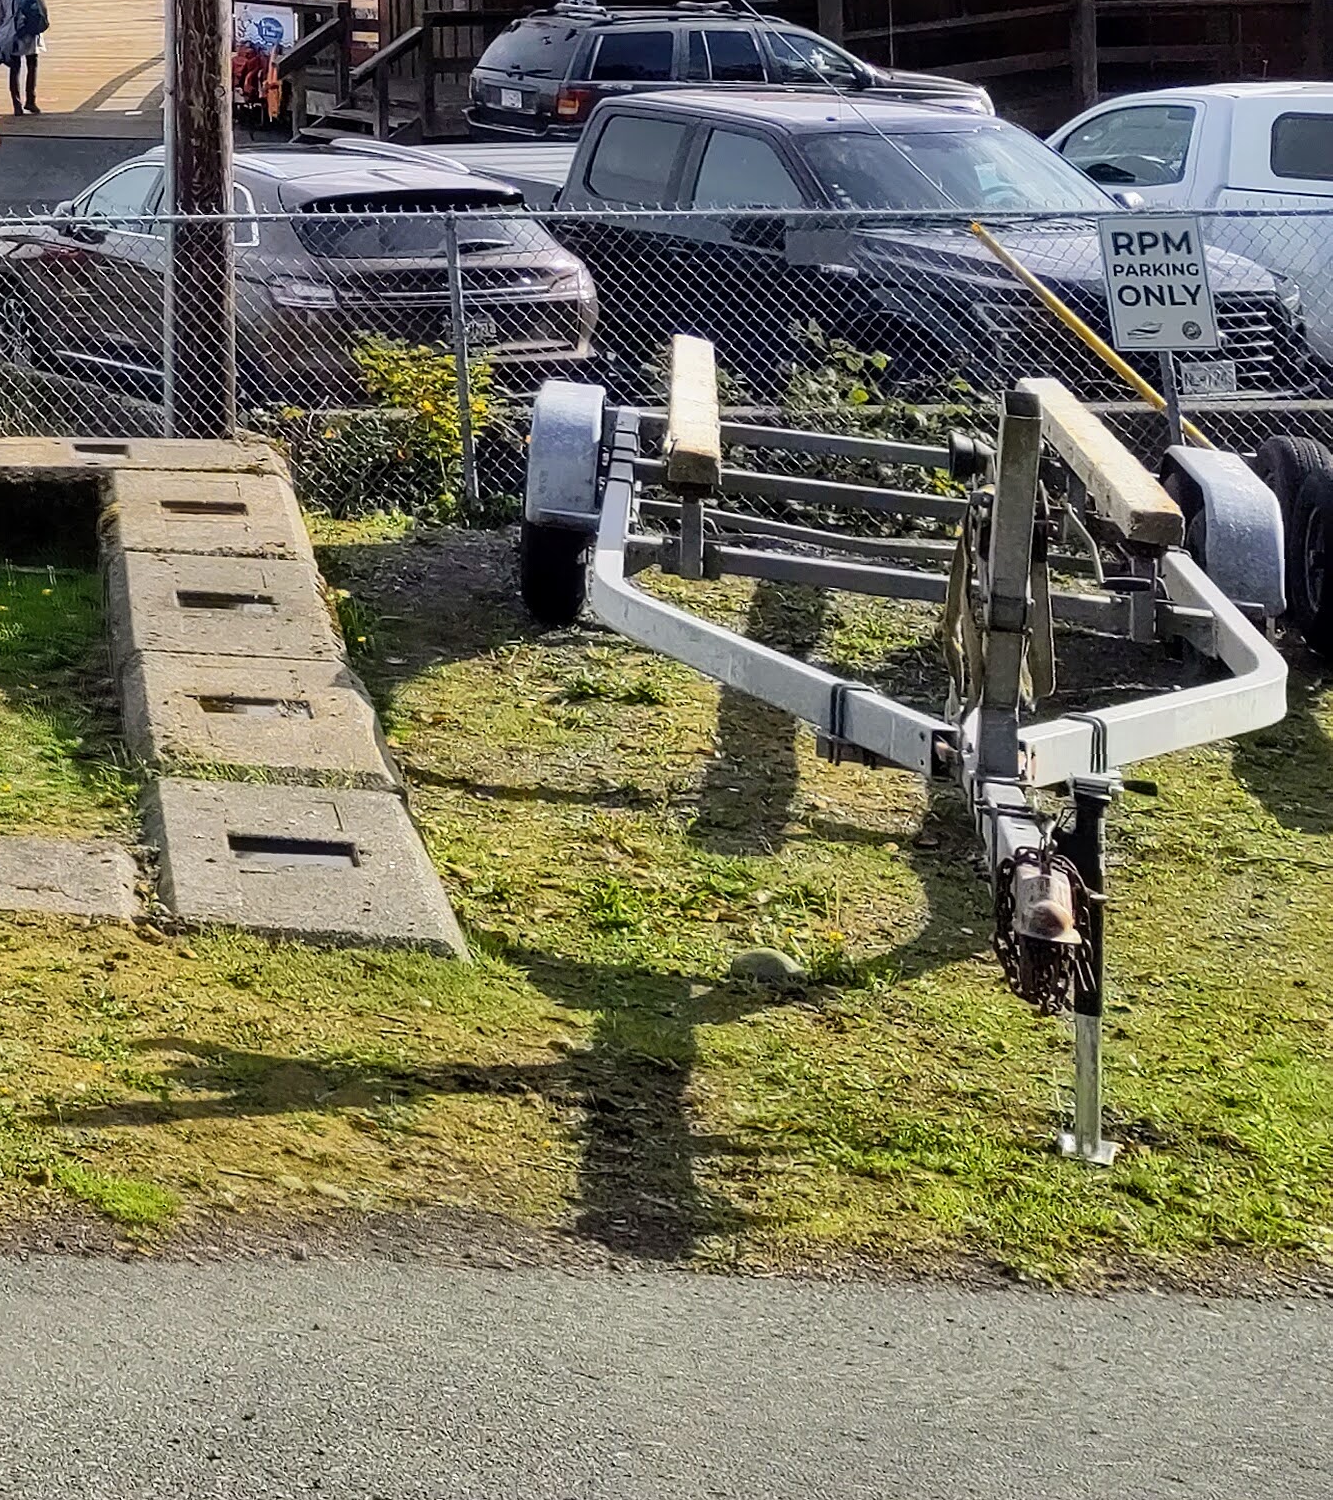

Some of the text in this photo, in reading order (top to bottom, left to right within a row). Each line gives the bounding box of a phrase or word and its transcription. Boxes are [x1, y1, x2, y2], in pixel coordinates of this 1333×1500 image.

[1111, 230, 1193, 256] RPM
[1113, 262, 1199, 277] PARKING
[1117, 284, 1202, 307] ONLY
